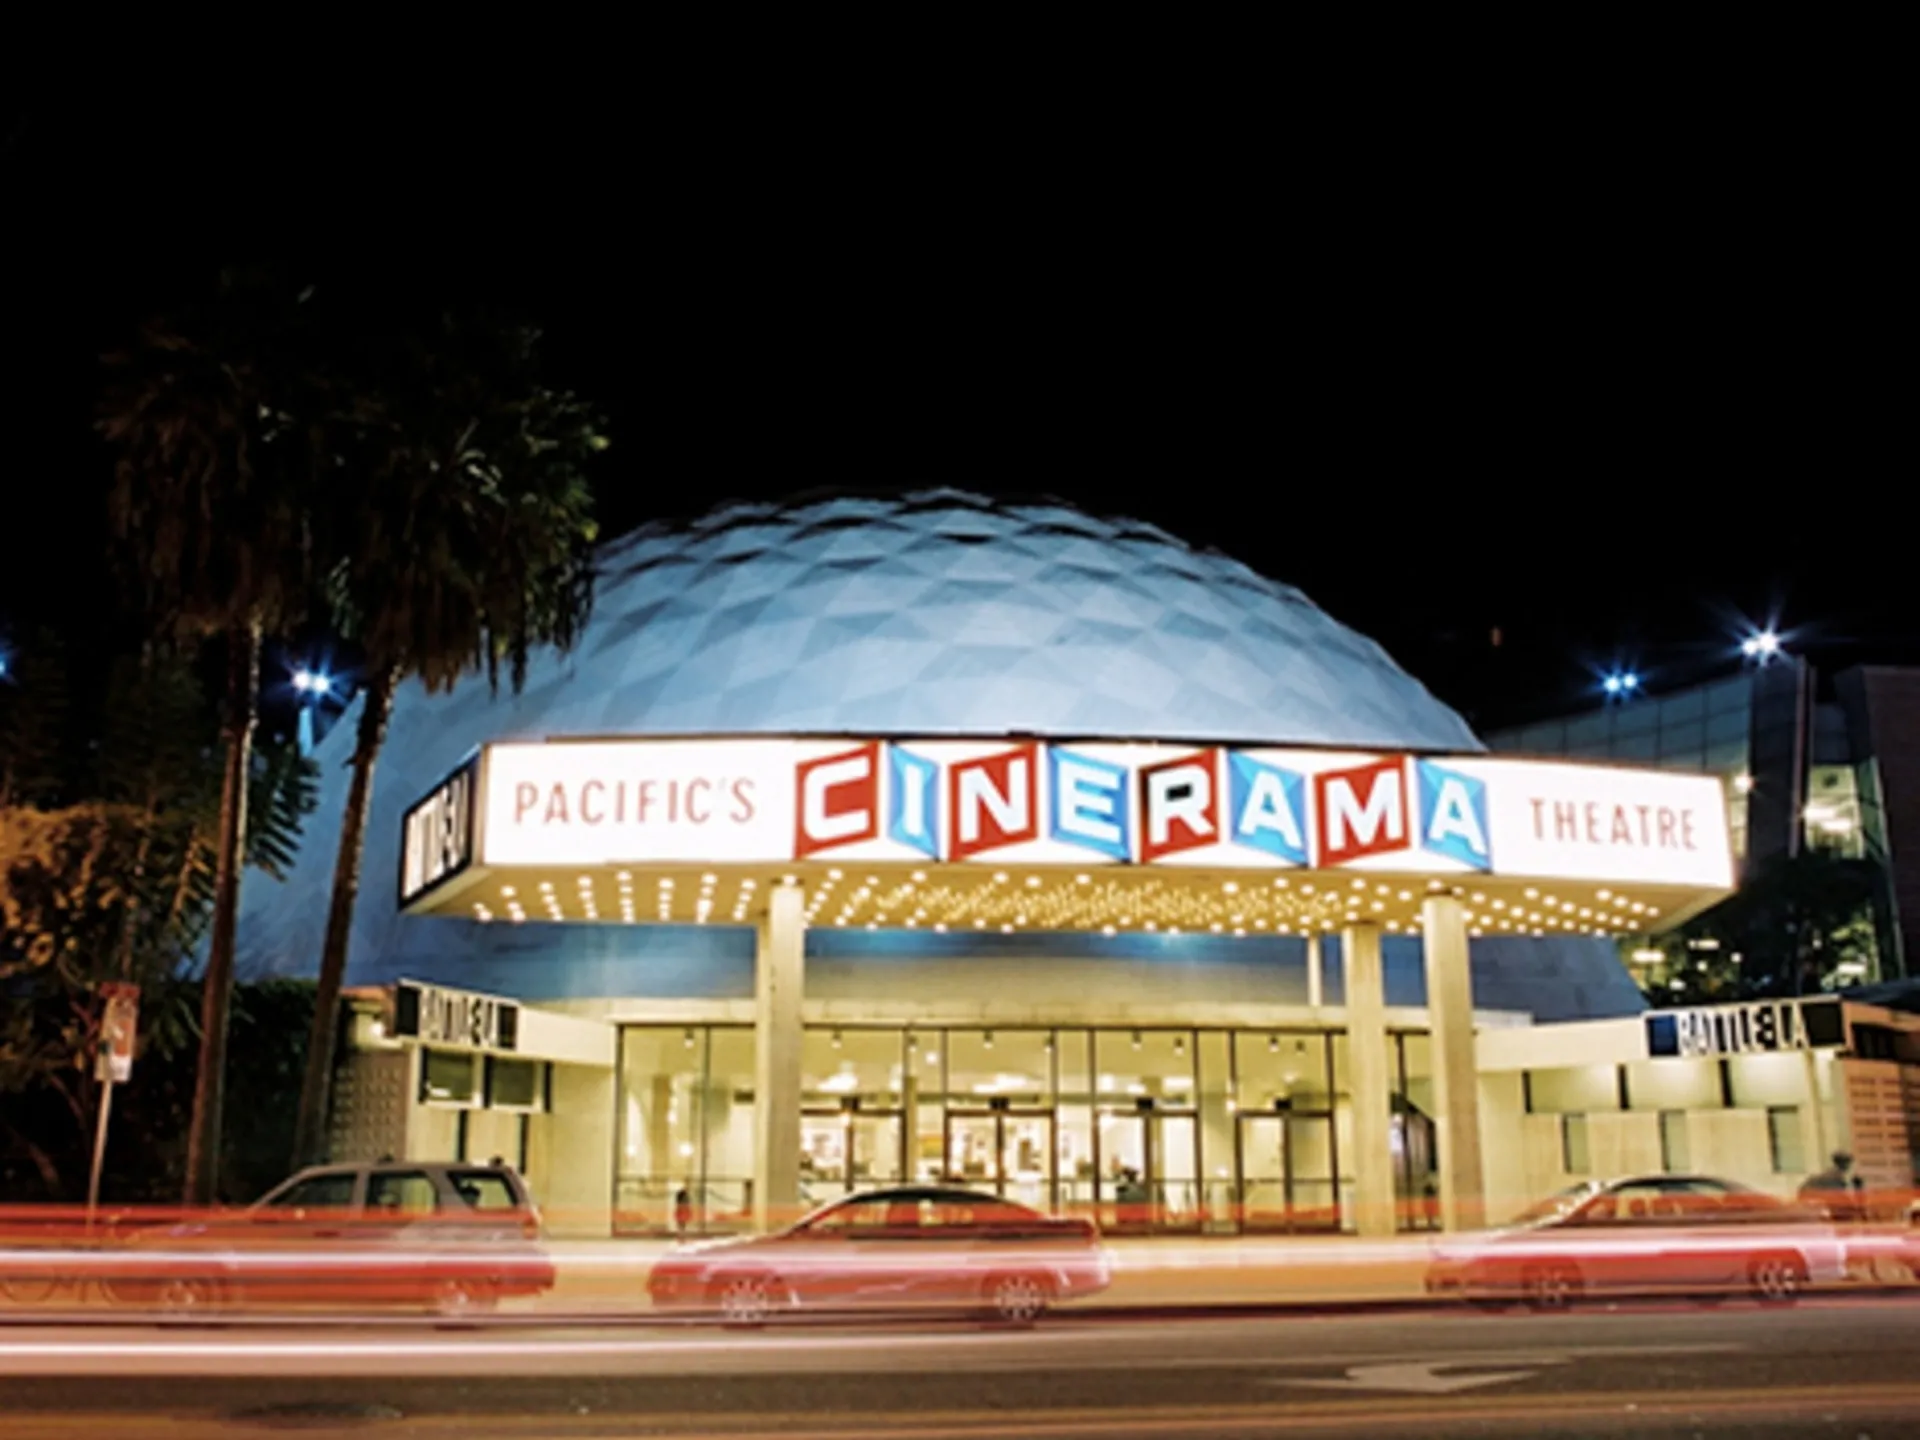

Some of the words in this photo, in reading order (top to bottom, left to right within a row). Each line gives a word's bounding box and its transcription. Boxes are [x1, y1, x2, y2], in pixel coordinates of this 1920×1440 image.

[514, 777, 756, 825] PACIFIC'S
[802, 754, 1488, 856] CINERAMA
[1529, 798, 1698, 852] THEATRE
